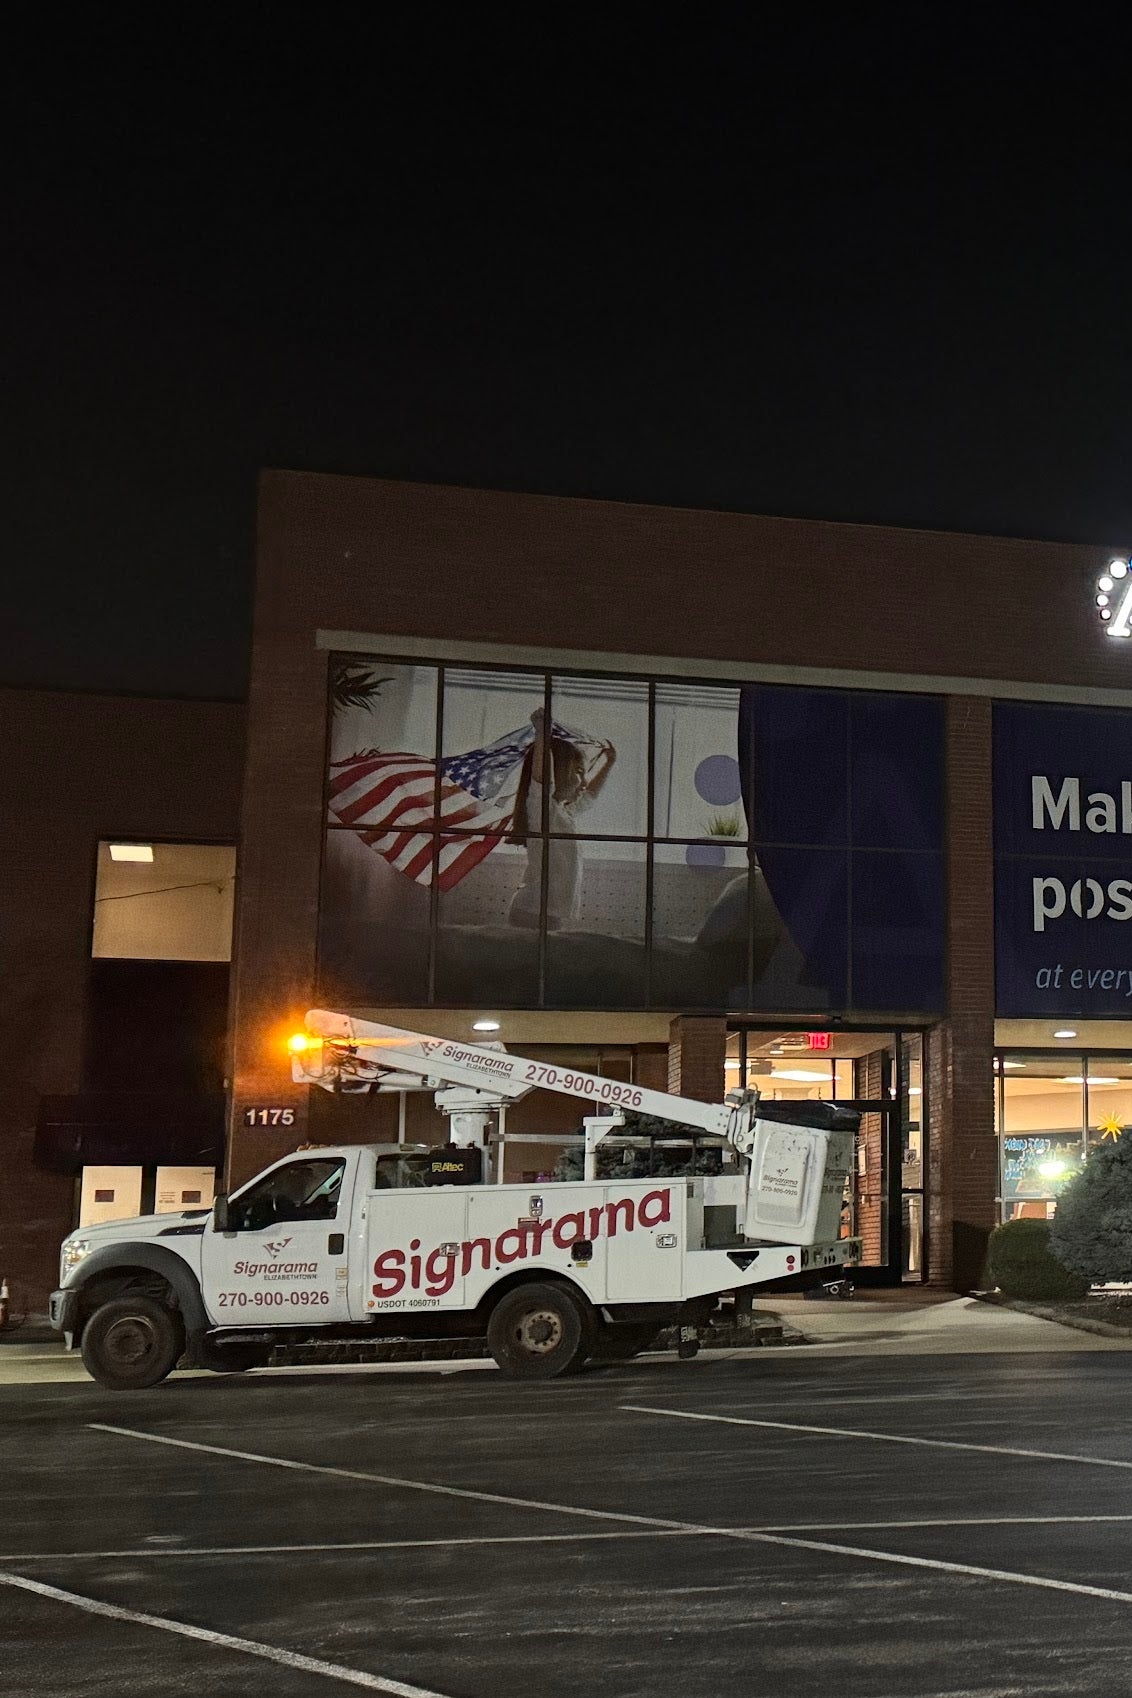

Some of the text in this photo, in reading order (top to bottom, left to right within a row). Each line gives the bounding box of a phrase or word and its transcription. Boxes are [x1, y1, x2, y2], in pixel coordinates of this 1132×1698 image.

[1035, 963, 1063, 989] at
[442, 1045, 515, 1073] Signarama
[525, 1064, 644, 1108] 270-900-0926
[246, 1108, 295, 1126] 1175
[372, 1188, 671, 1299] Signarama
[233, 1261, 318, 1278] Signarama
[263, 1273, 318, 1281] ELIZABETHTOWN
[218, 1291, 330, 1307] 270-900-0926
[377, 1300, 406, 1308] USDOT
